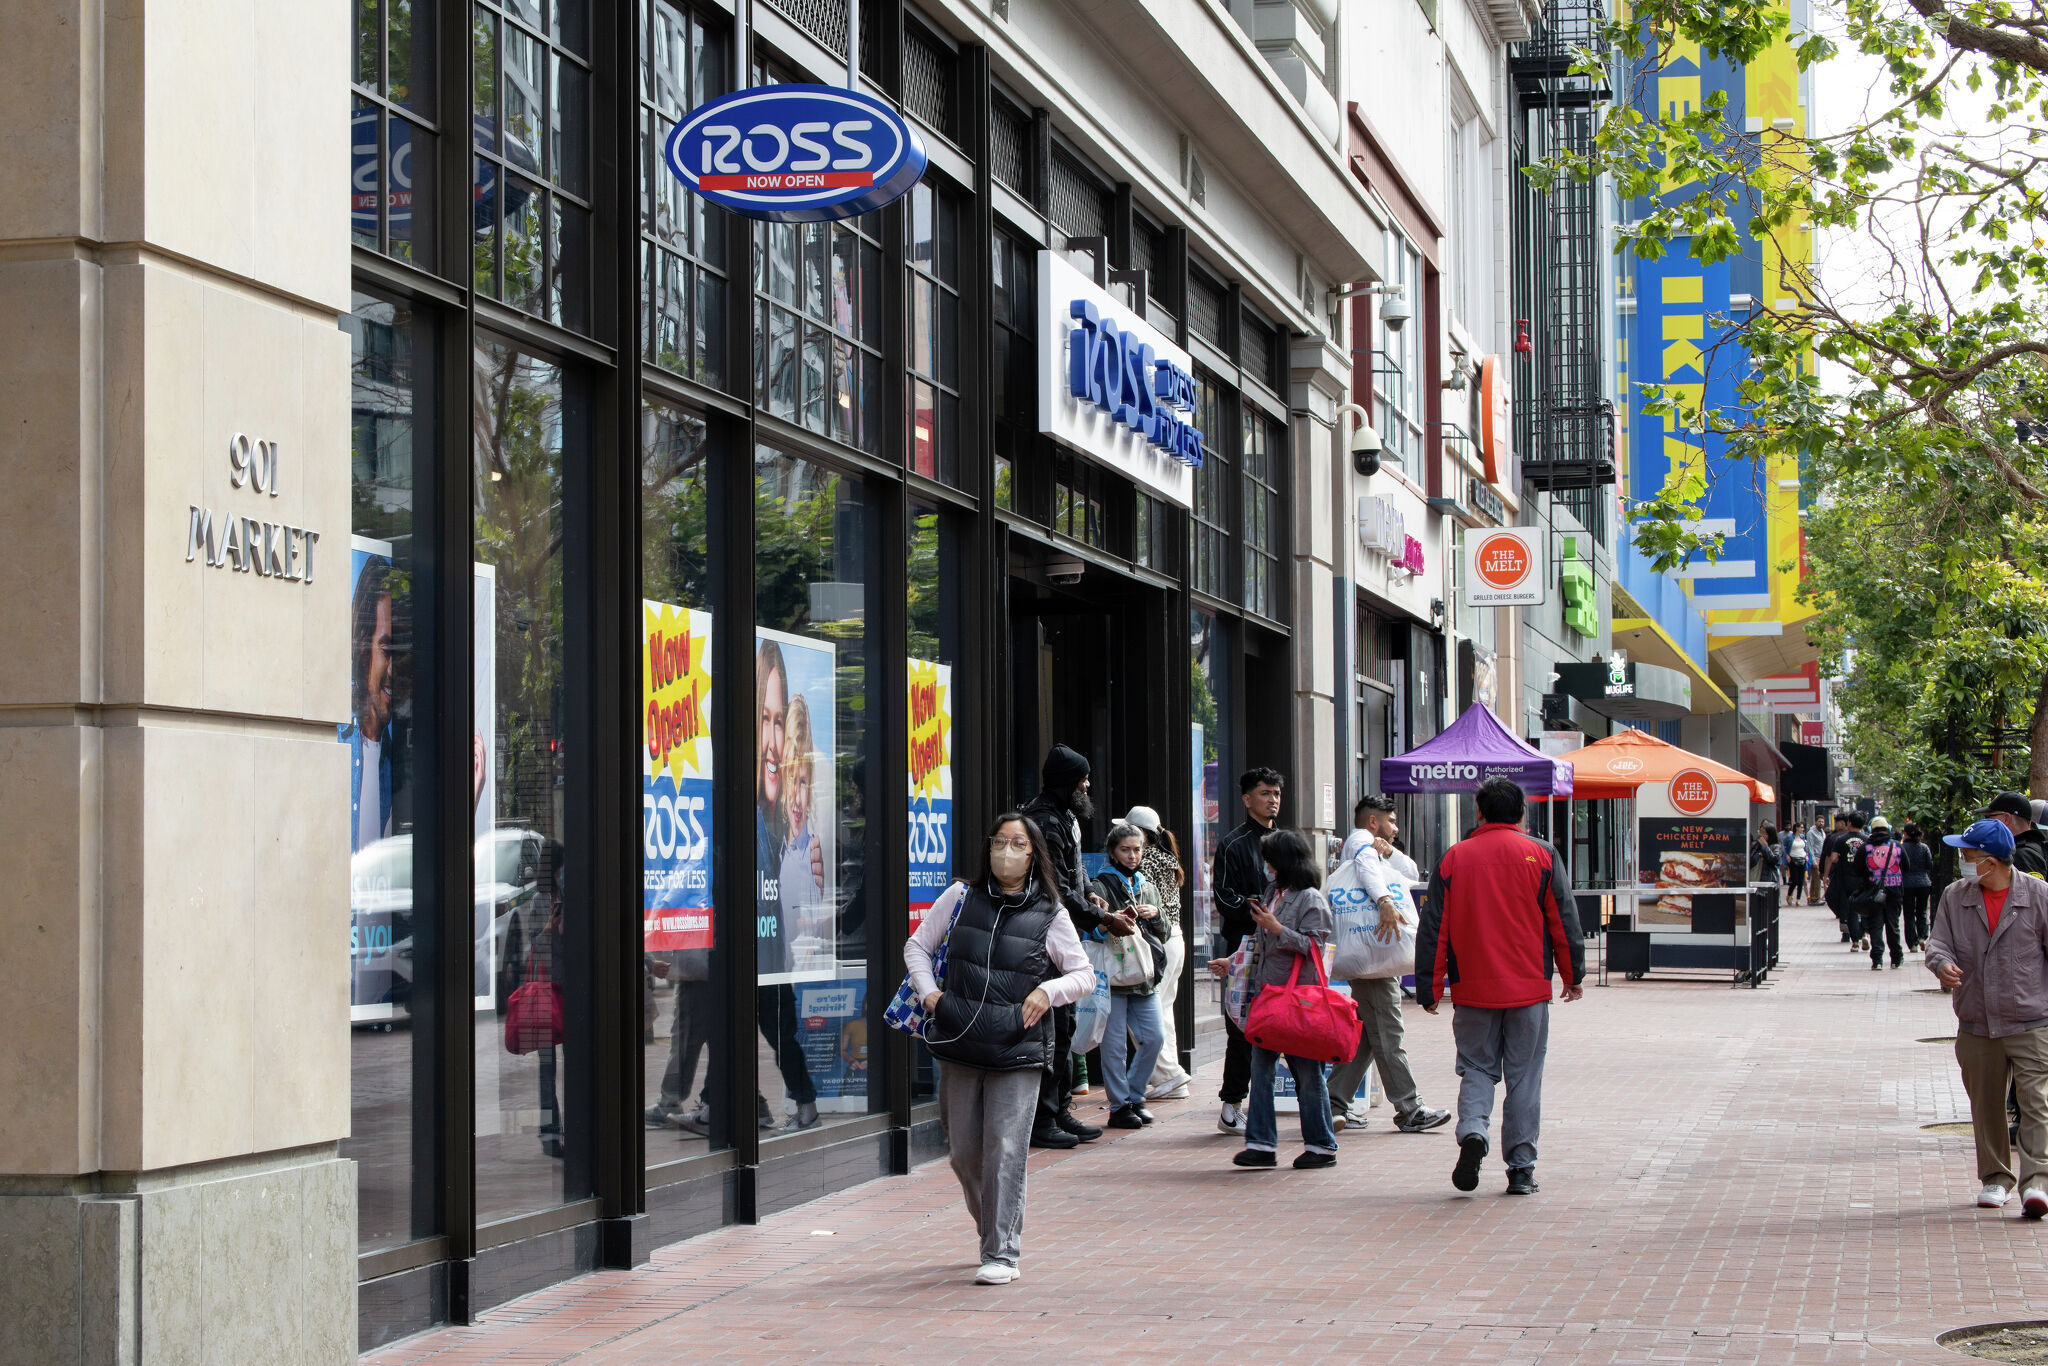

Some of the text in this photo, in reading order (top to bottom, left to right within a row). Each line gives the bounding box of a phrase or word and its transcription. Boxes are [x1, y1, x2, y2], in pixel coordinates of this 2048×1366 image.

[702, 120, 872, 174] ROSS
[747, 175, 824, 188] NOW OPEN
[1070, 299, 1156, 437] ROSS
[1662, 276, 1706, 498] IKEA
[230, 432, 278, 497] 901
[186, 504, 320, 584] MARKET
[1492, 550, 1515, 560] THE
[1485, 559, 1523, 572] MELT
[650, 629, 690, 693] Now
[911, 680, 937, 731] Now
[648, 678, 698, 768] Open!
[911, 719, 942, 790] Open!
[1484, 765, 1524, 773] Authorized
[1409, 761, 1478, 787] metro
[1683, 782, 1703, 791] THE
[1677, 790, 1709, 801] MELT
[644, 794, 705, 860] ROSS
[644, 869, 706, 890] RESS FOR LESS
[761, 870, 778, 901] less
[909, 872, 947, 887] RESS FOR LESS
[1329, 883, 1403, 906] ROS
